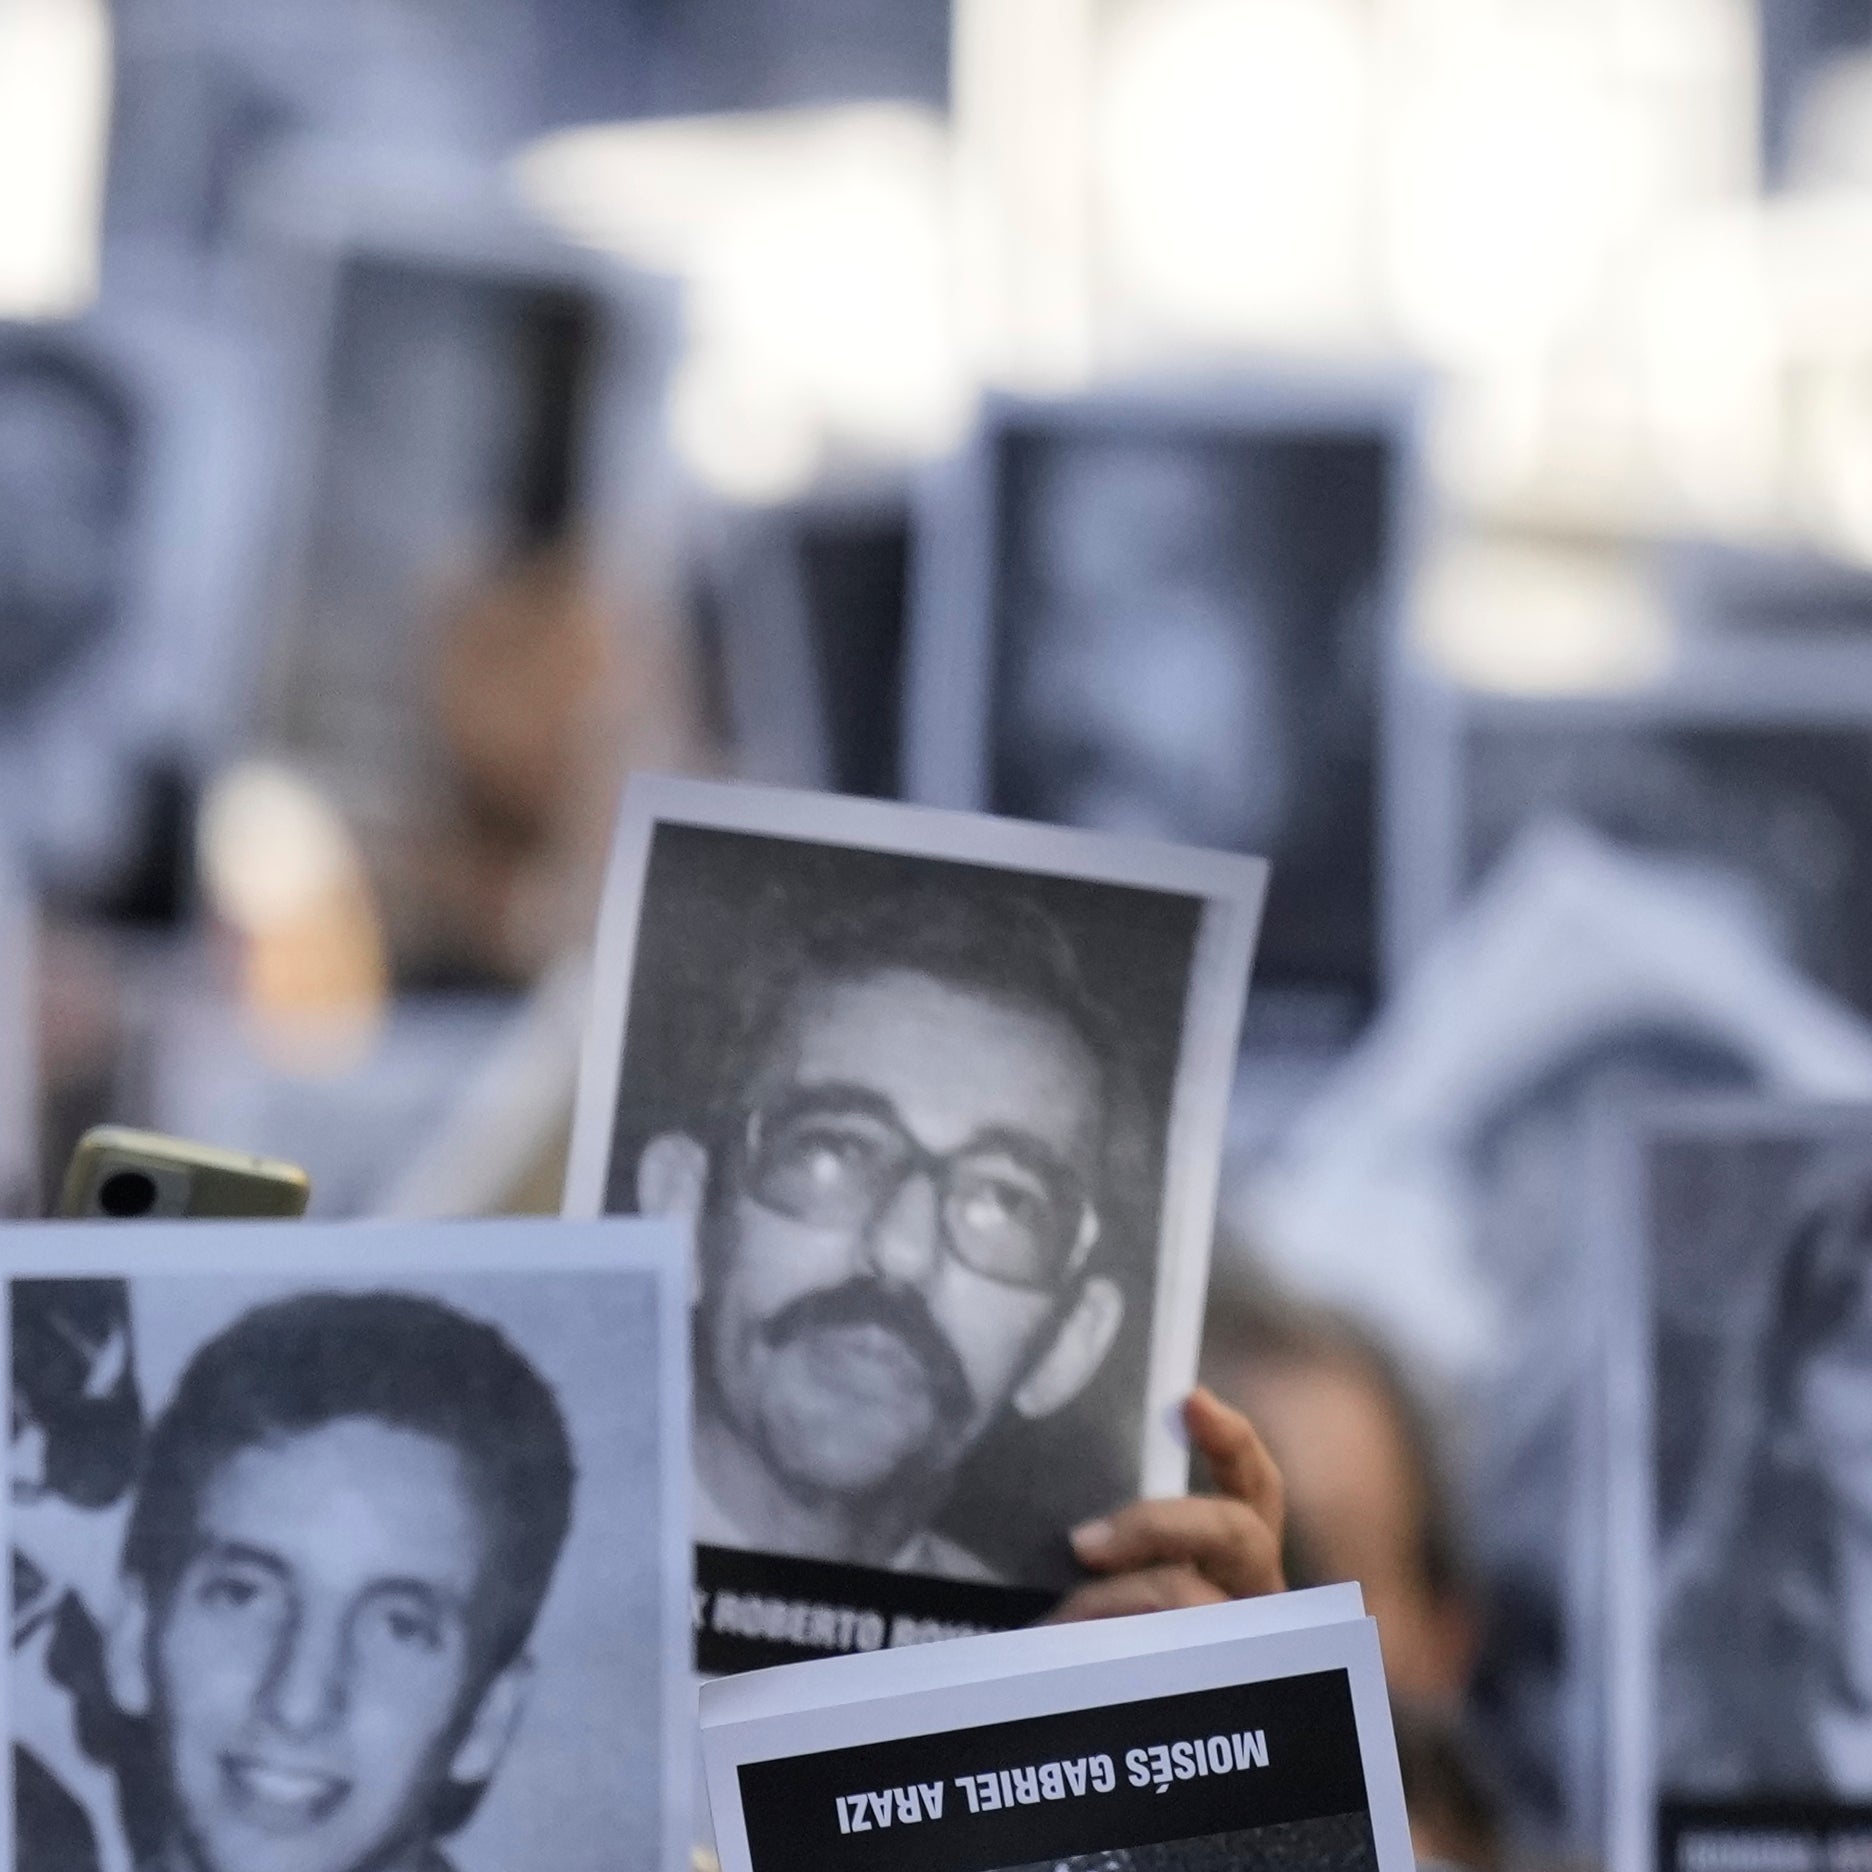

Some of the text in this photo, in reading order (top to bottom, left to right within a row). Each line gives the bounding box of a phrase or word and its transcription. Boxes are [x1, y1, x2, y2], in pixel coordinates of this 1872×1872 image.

[836, 1729, 1270, 1834] MOISÉS GABRIEL ARAZI
